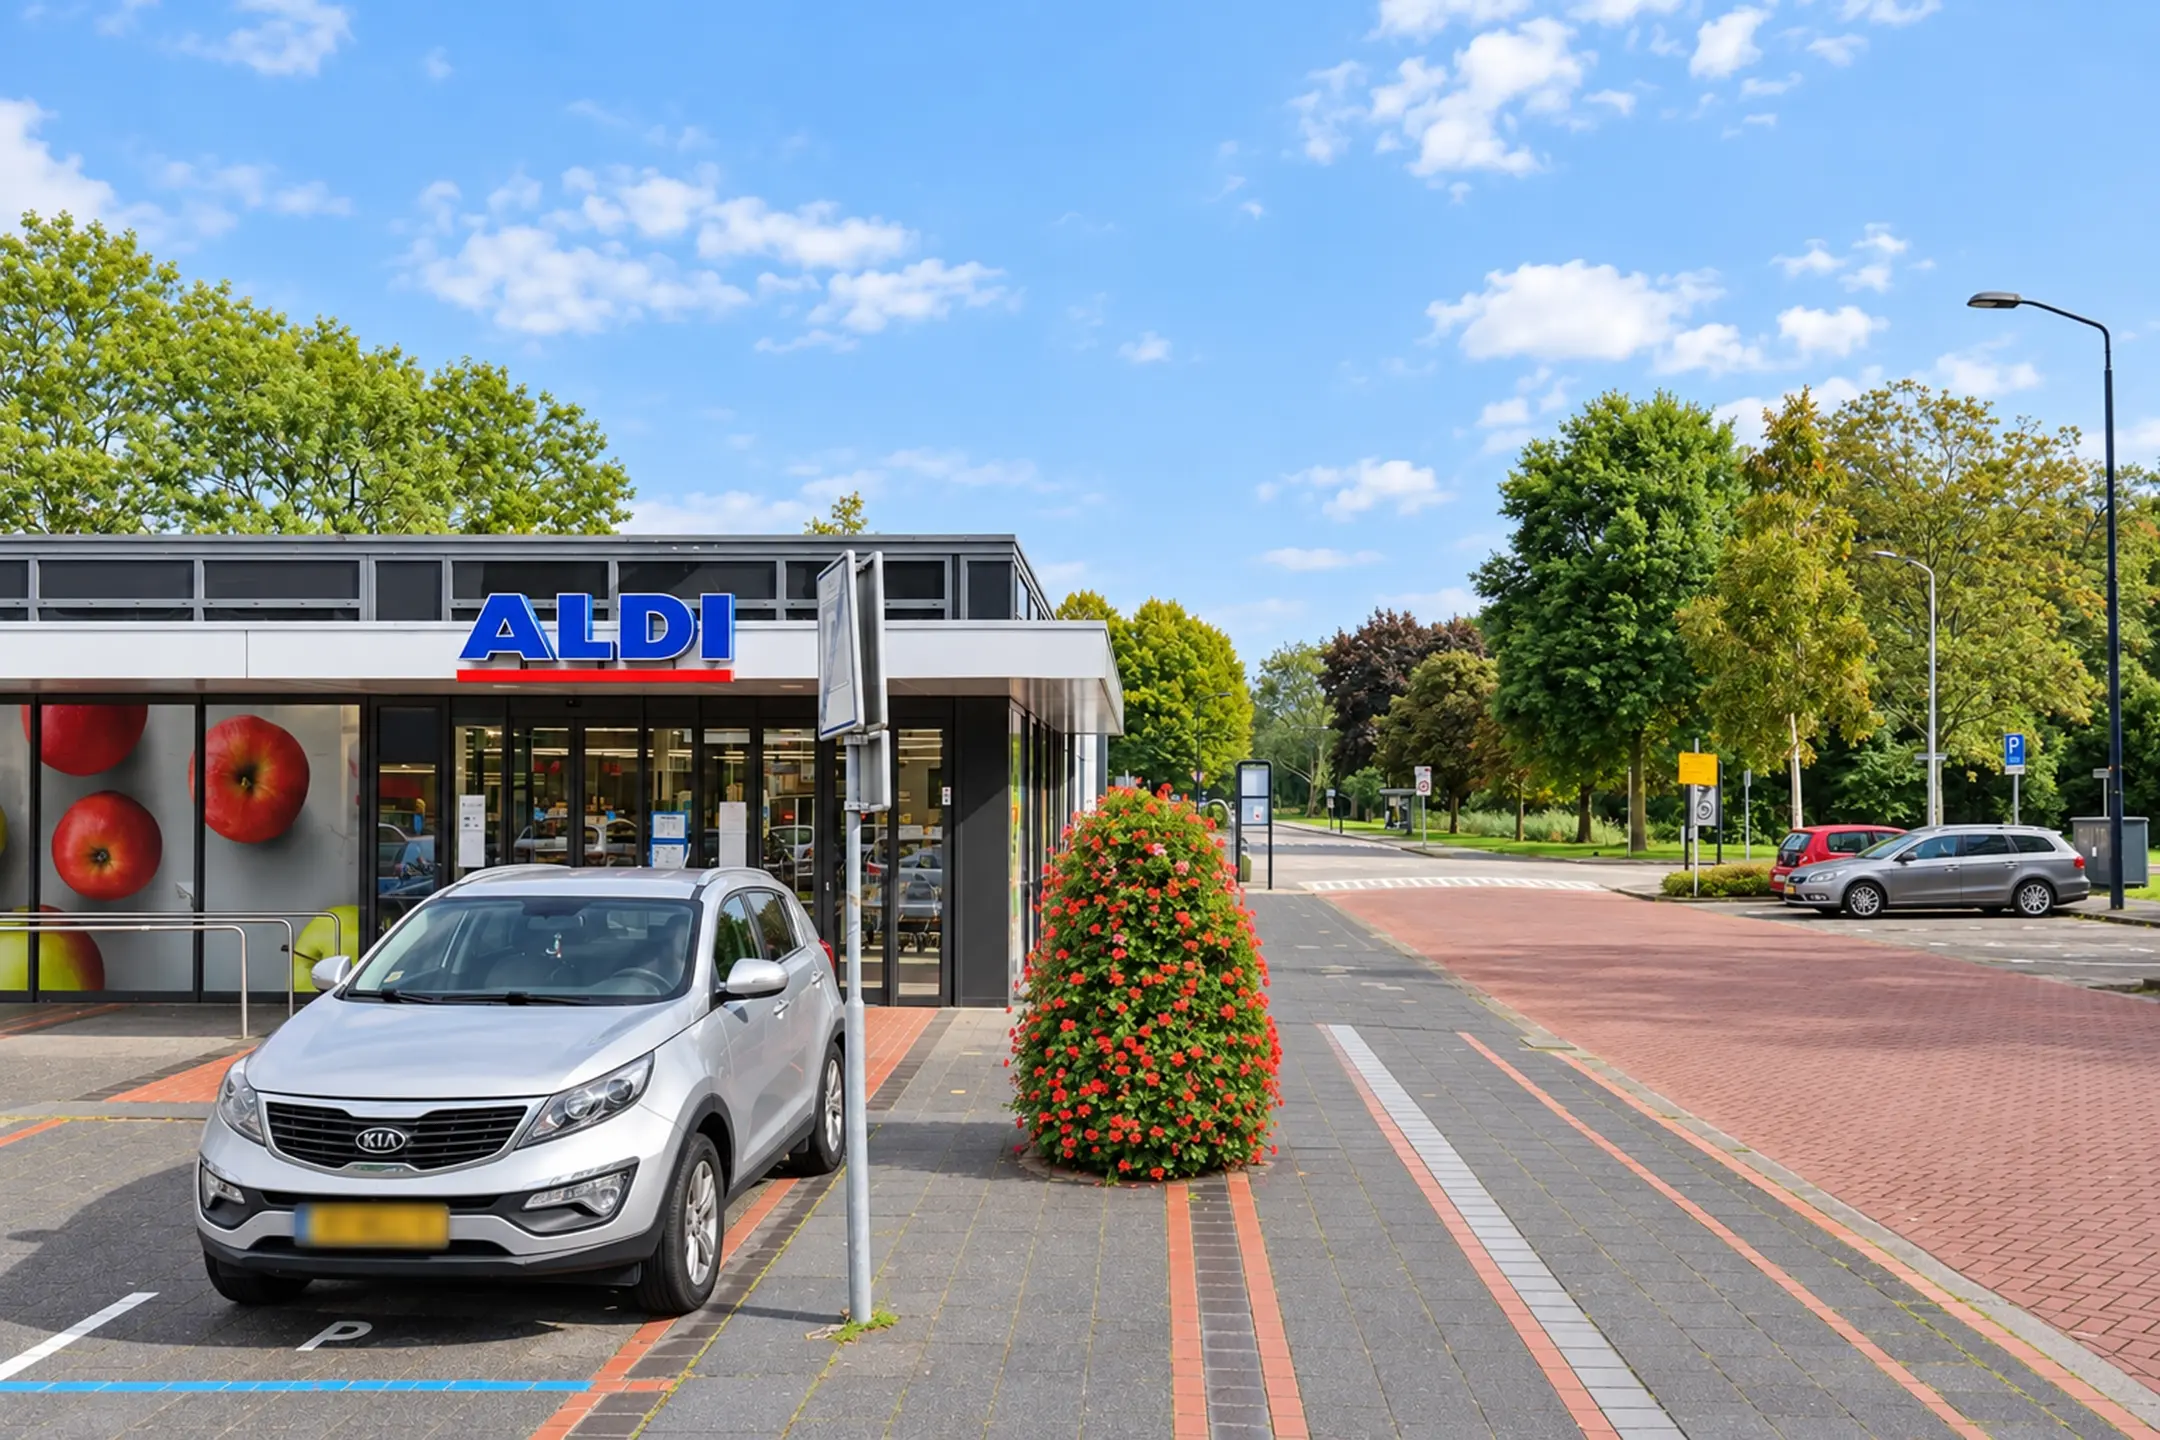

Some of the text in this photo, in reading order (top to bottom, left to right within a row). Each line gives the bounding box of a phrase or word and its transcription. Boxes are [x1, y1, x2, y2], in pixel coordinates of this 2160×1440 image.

[458, 593, 735, 661] ALDI
[2009, 737, 2020, 754] P
[363, 1133, 397, 1148] KIA
[295, 1321, 373, 1351] P
